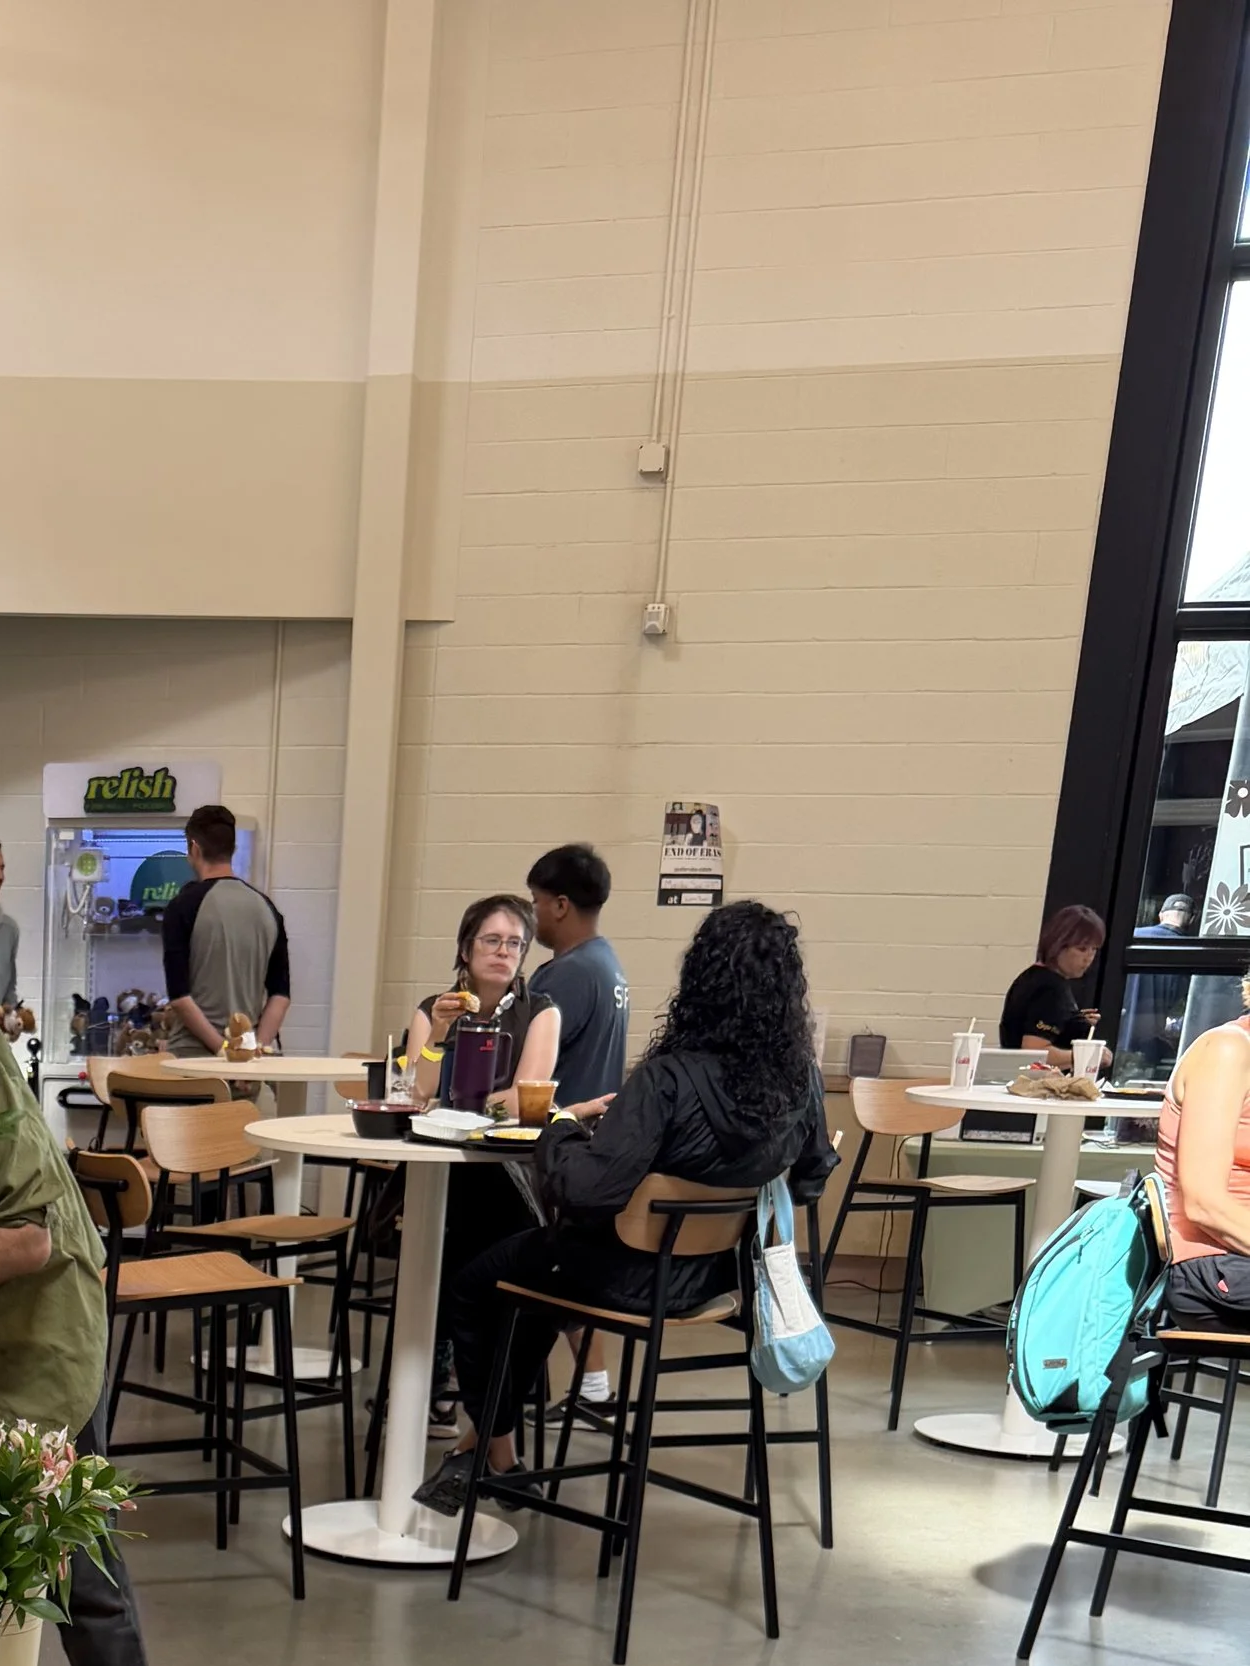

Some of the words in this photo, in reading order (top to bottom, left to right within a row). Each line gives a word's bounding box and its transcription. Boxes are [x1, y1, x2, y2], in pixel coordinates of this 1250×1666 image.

[86, 768, 174, 800] relish
[664, 847, 684, 857] END
[685, 847, 699, 857] OF
[700, 847, 722, 858] ERAS
[667, 895, 678, 905] at
